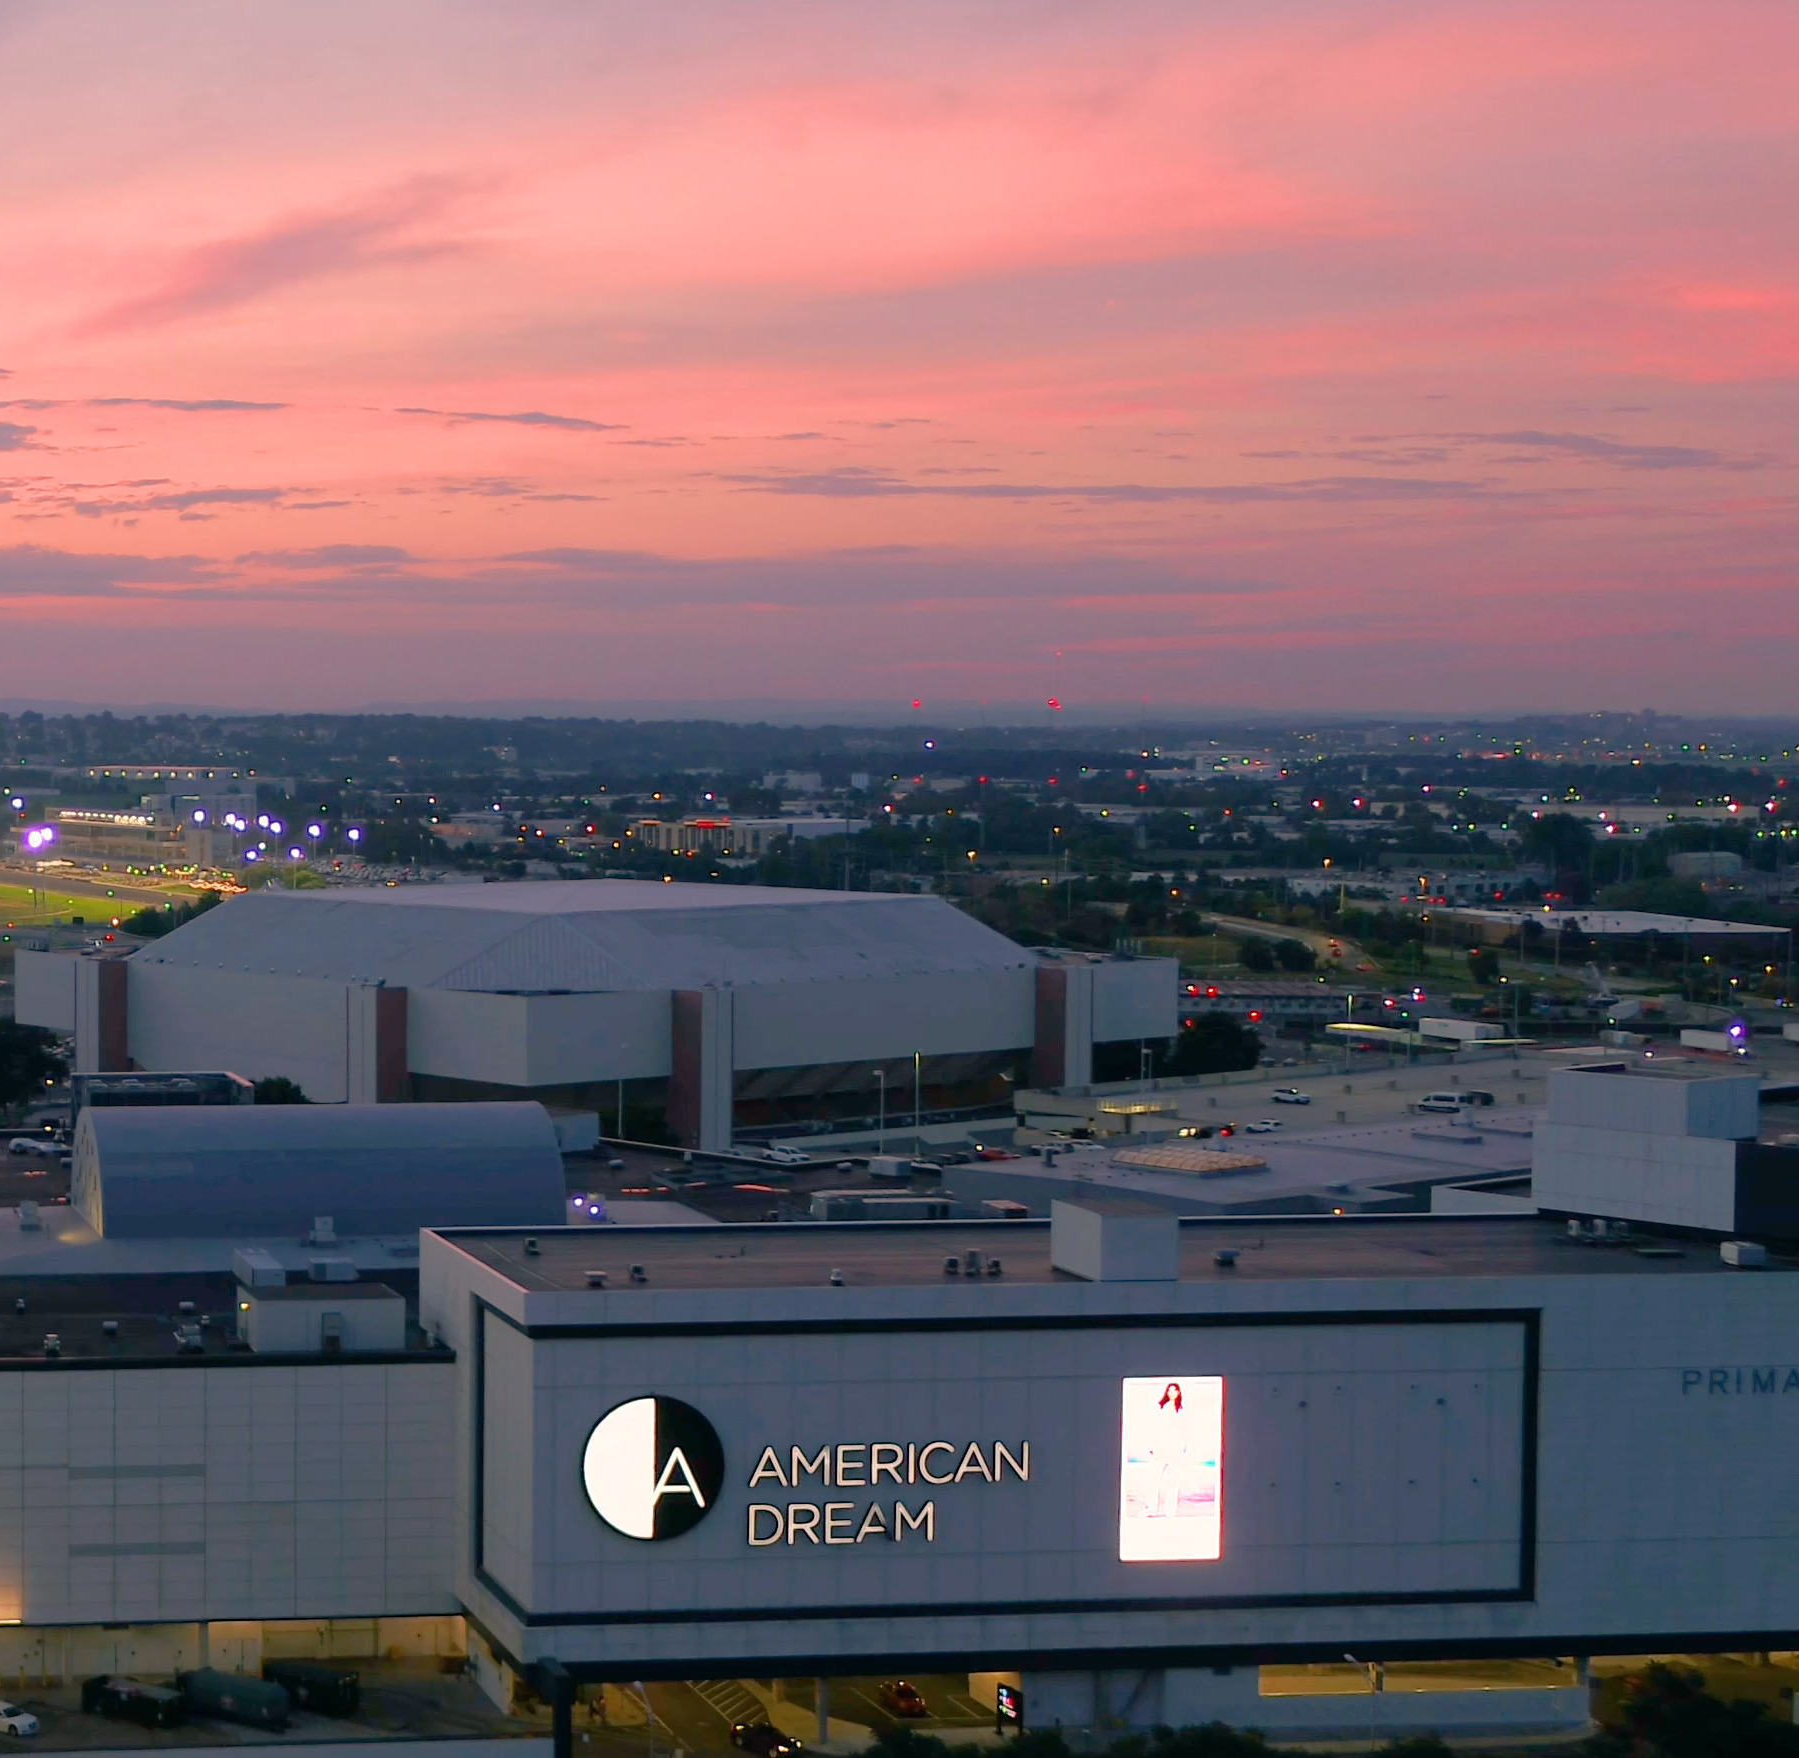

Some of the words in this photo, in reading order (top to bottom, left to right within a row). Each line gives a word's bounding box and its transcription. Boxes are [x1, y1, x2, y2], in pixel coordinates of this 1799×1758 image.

[1681, 1367, 1799, 1395] PRIMA
[748, 1440, 1030, 1488] AMERICAN
[747, 1500, 936, 1546] DREAM
